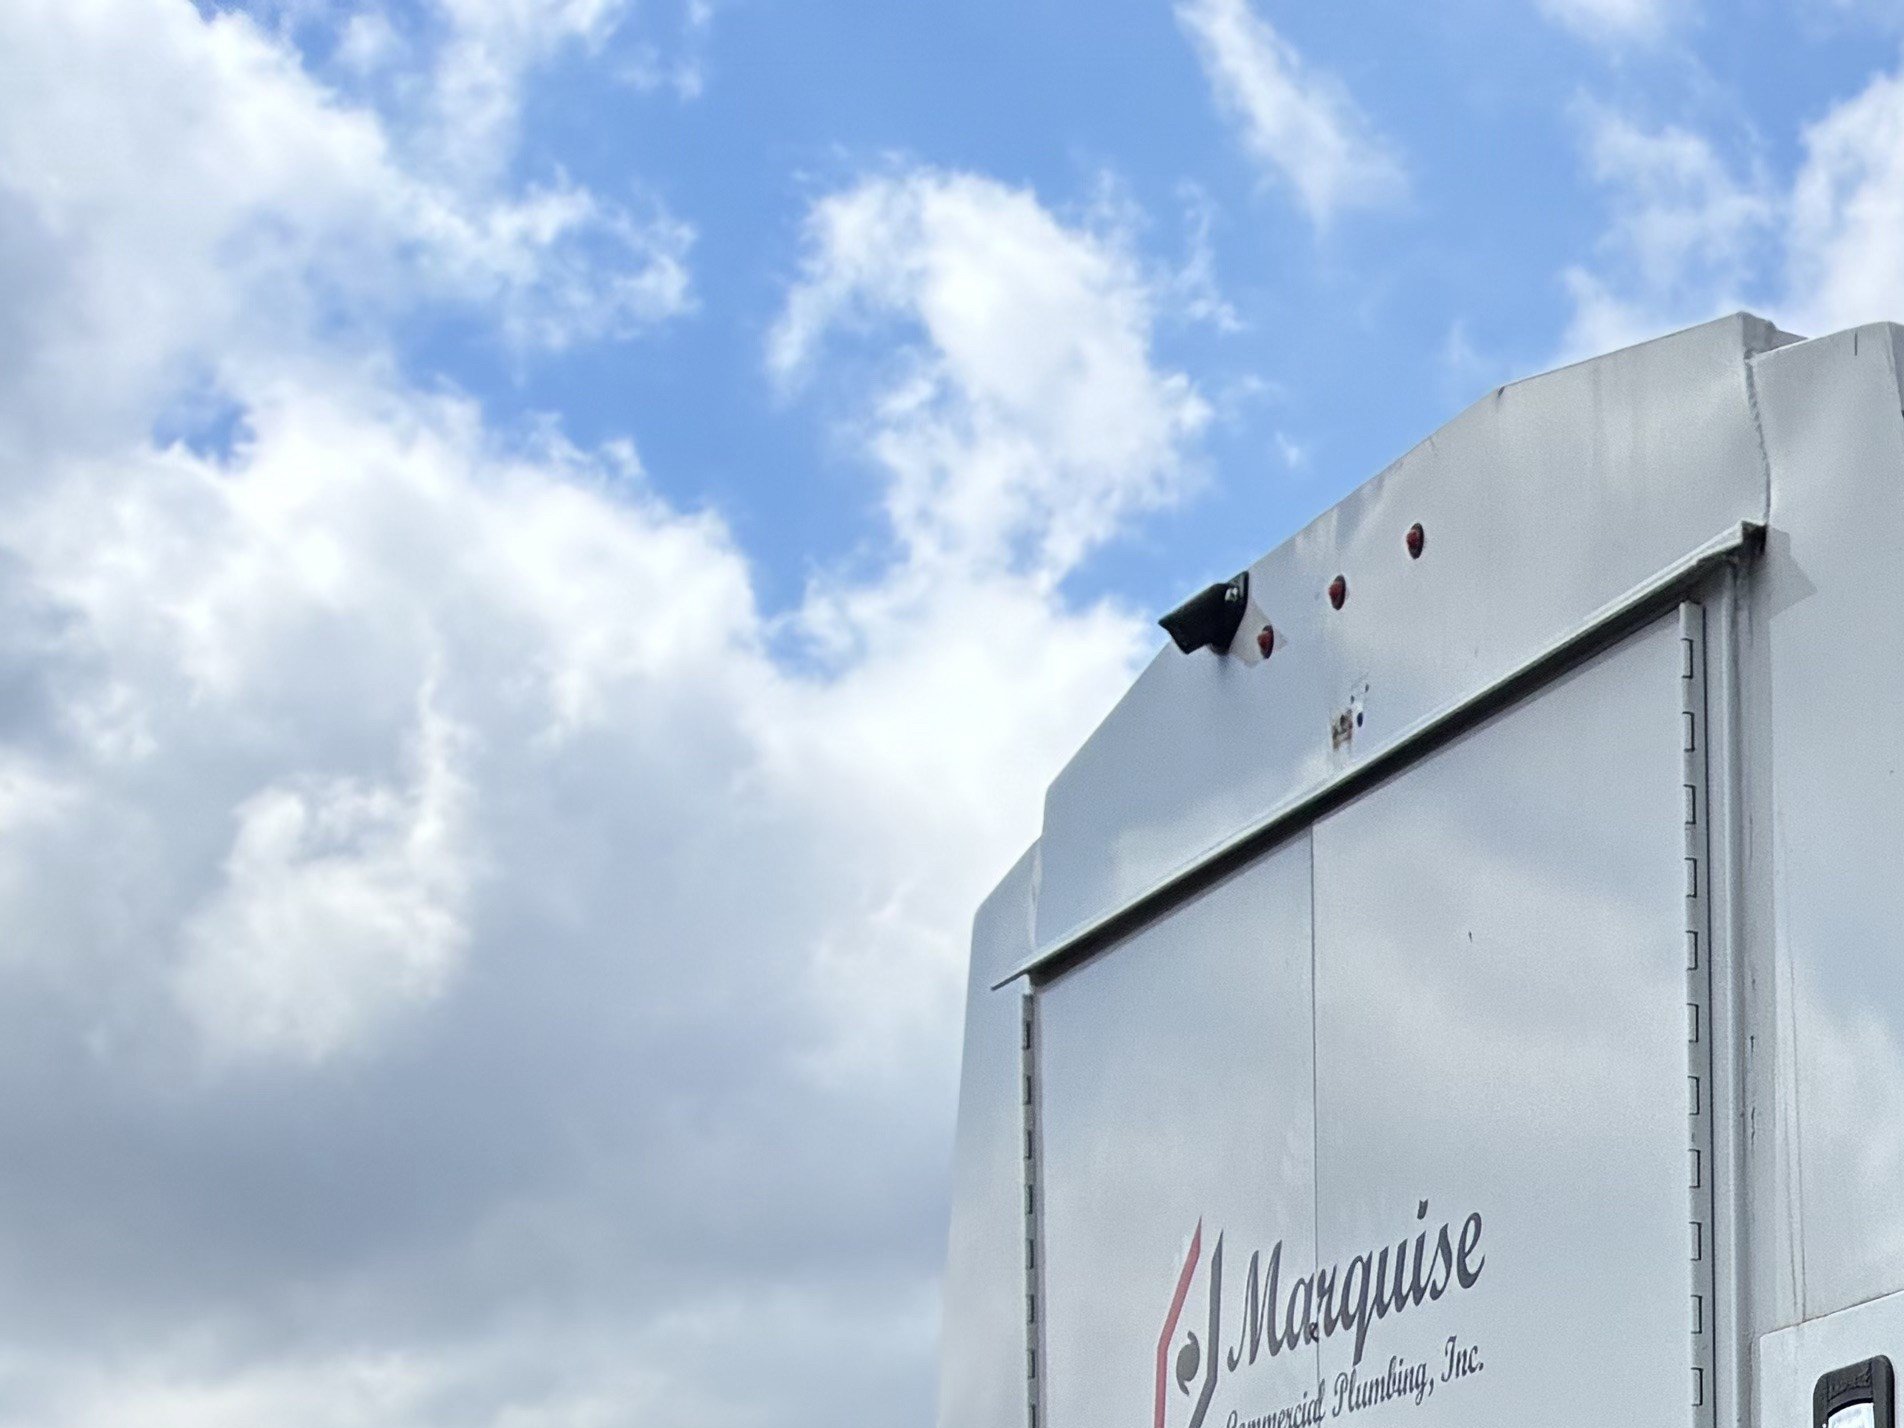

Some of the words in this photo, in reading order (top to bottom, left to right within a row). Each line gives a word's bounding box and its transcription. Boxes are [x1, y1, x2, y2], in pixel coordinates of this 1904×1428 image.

[1226, 1199, 1486, 1371] Marquise
[1332, 1354, 1435, 1418] Plumbing,
[1440, 1334, 1485, 1380] Inc.
